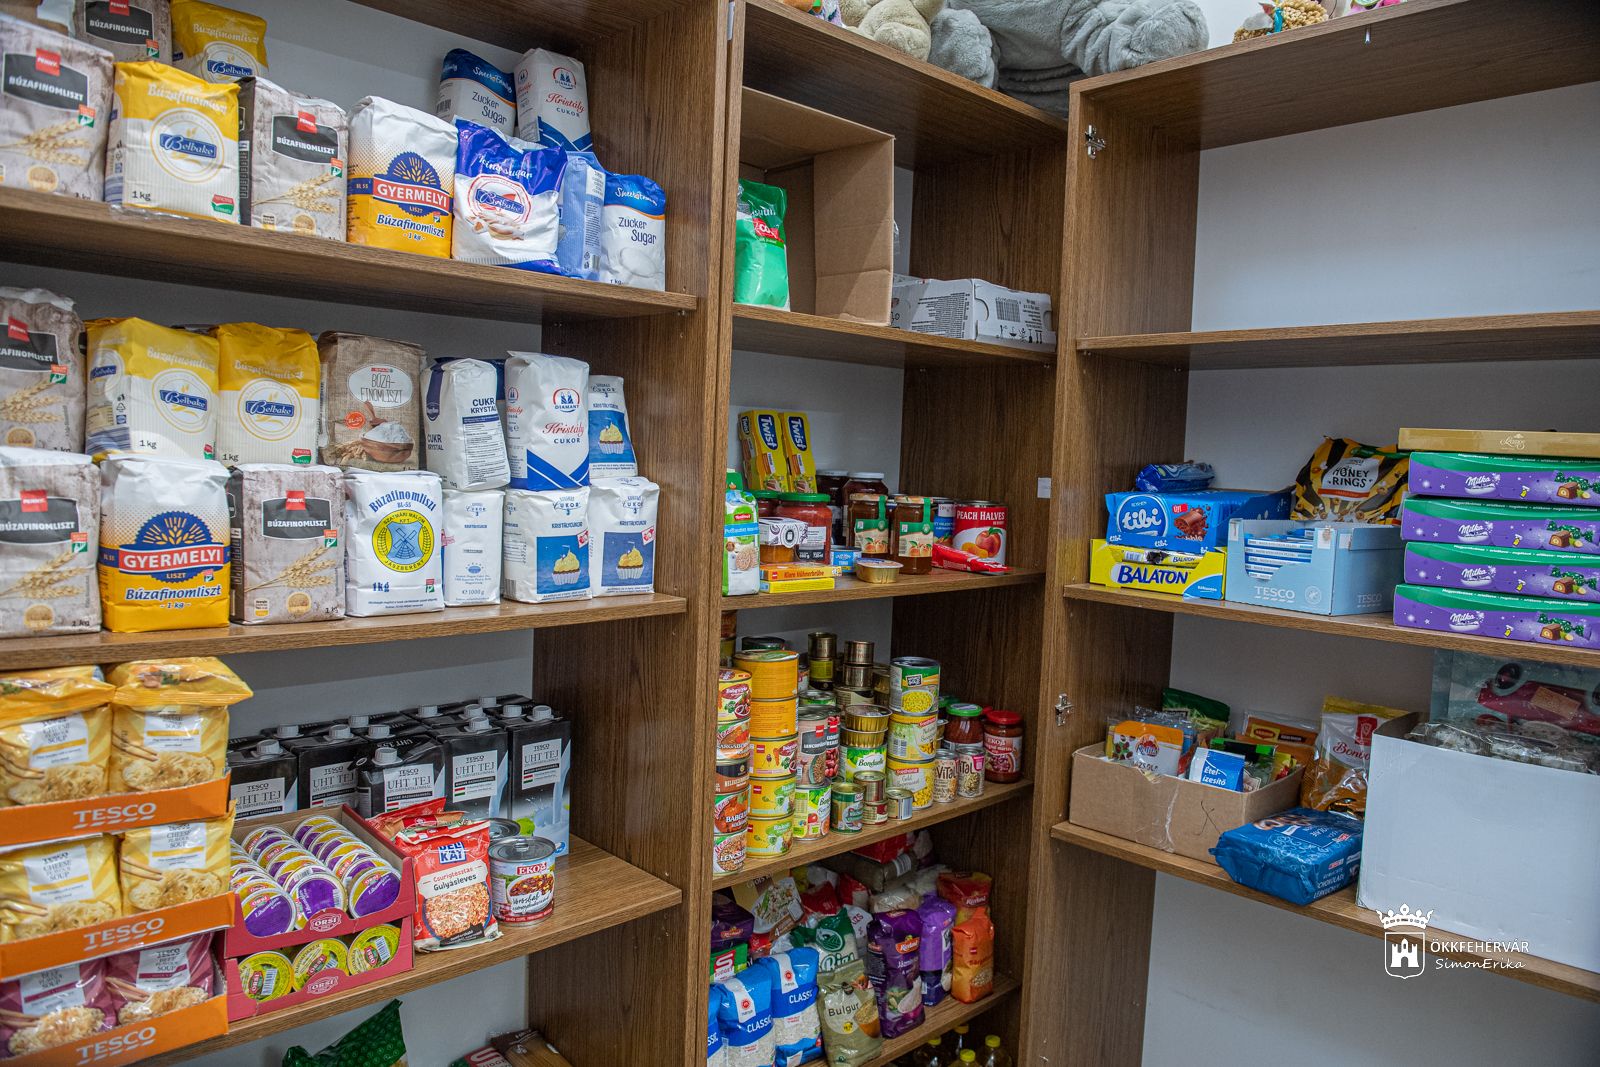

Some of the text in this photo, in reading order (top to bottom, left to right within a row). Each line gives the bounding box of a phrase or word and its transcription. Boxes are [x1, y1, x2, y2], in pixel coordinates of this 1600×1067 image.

[89, 19, 149, 36] BÚZAFINOMLISZT
[9, 75, 83, 101] BÚZAFINOMLISZT
[472, 92, 499, 109] Zucker
[546, 93, 585, 113] Kristály
[481, 105, 508, 125] Sugar
[556, 108, 580, 118] CUKOR
[165, 136, 215, 157] Belbake
[276, 136, 335, 155] BÚZAFINOMLISZT
[139, 192, 151, 202] kg
[377, 184, 447, 208] GYERMELYI
[377, 214, 445, 237] Búzafinomliszt
[618, 217, 647, 230] Zucker
[631, 229, 657, 246] Sugar
[0, 348, 54, 362] AFINOMLISZT
[164, 390, 207, 410] Belbake
[360, 388, 402, 405] FINOMLISZT
[473, 398, 495, 407] CUKR
[250, 401, 293, 417] Belbake
[555, 404, 579, 412] DIAMANT
[543, 422, 584, 437] Kristály
[761, 416, 777, 449] Twist
[790, 418, 807, 449] Twist
[146, 440, 157, 450] kg
[427, 435, 442, 443] CUKR
[229, 453, 239, 463] kg
[1333, 467, 1370, 481] HONEY
[1466, 476, 1491, 486] Milka
[1333, 477, 1366, 489] RINGS
[369, 490, 436, 513] Búzafinomliszt
[957, 510, 1005, 521] PEACH HALVES
[1123, 508, 1161, 530] tibi
[0, 522, 74, 531] BÚZAFINOMLISZT
[268, 520, 327, 528] BÚZAFINOMLISZT
[1459, 524, 1484, 535] Milka
[1154, 540, 1168, 548] tibi
[124, 550, 220, 569] GYERMELYI
[1117, 566, 1189, 585] BALATON
[1462, 568, 1486, 579] Milka
[126, 585, 221, 601] Búzafinomliszt
[1255, 586, 1295, 600] TESCO
[1357, 593, 1382, 605] TESCO
[1450, 612, 1475, 624] Milka
[525, 749, 559, 764] UHT TEJ
[324, 766, 344, 775] TESCO
[399, 768, 419, 777] TESCO
[456, 761, 495, 776] UHT TEJ
[1204, 765, 1220, 777] Étel-
[313, 771, 354, 788] UHT TEJ
[388, 775, 431, 790] UHT TEJ
[1203, 774, 1226, 786] ízesítő
[247, 783, 269, 792] TESCO
[263, 790, 281, 800] TEJ
[74, 803, 156, 824] TESCO
[434, 873, 477, 891] Gulyásleves
[315, 917, 336, 928] ORSI
[83, 918, 164, 945] TESCO
[311, 978, 333, 990] ORSI
[828, 1001, 860, 1017] Bulgur
[77, 1027, 157, 1059] TESCO
